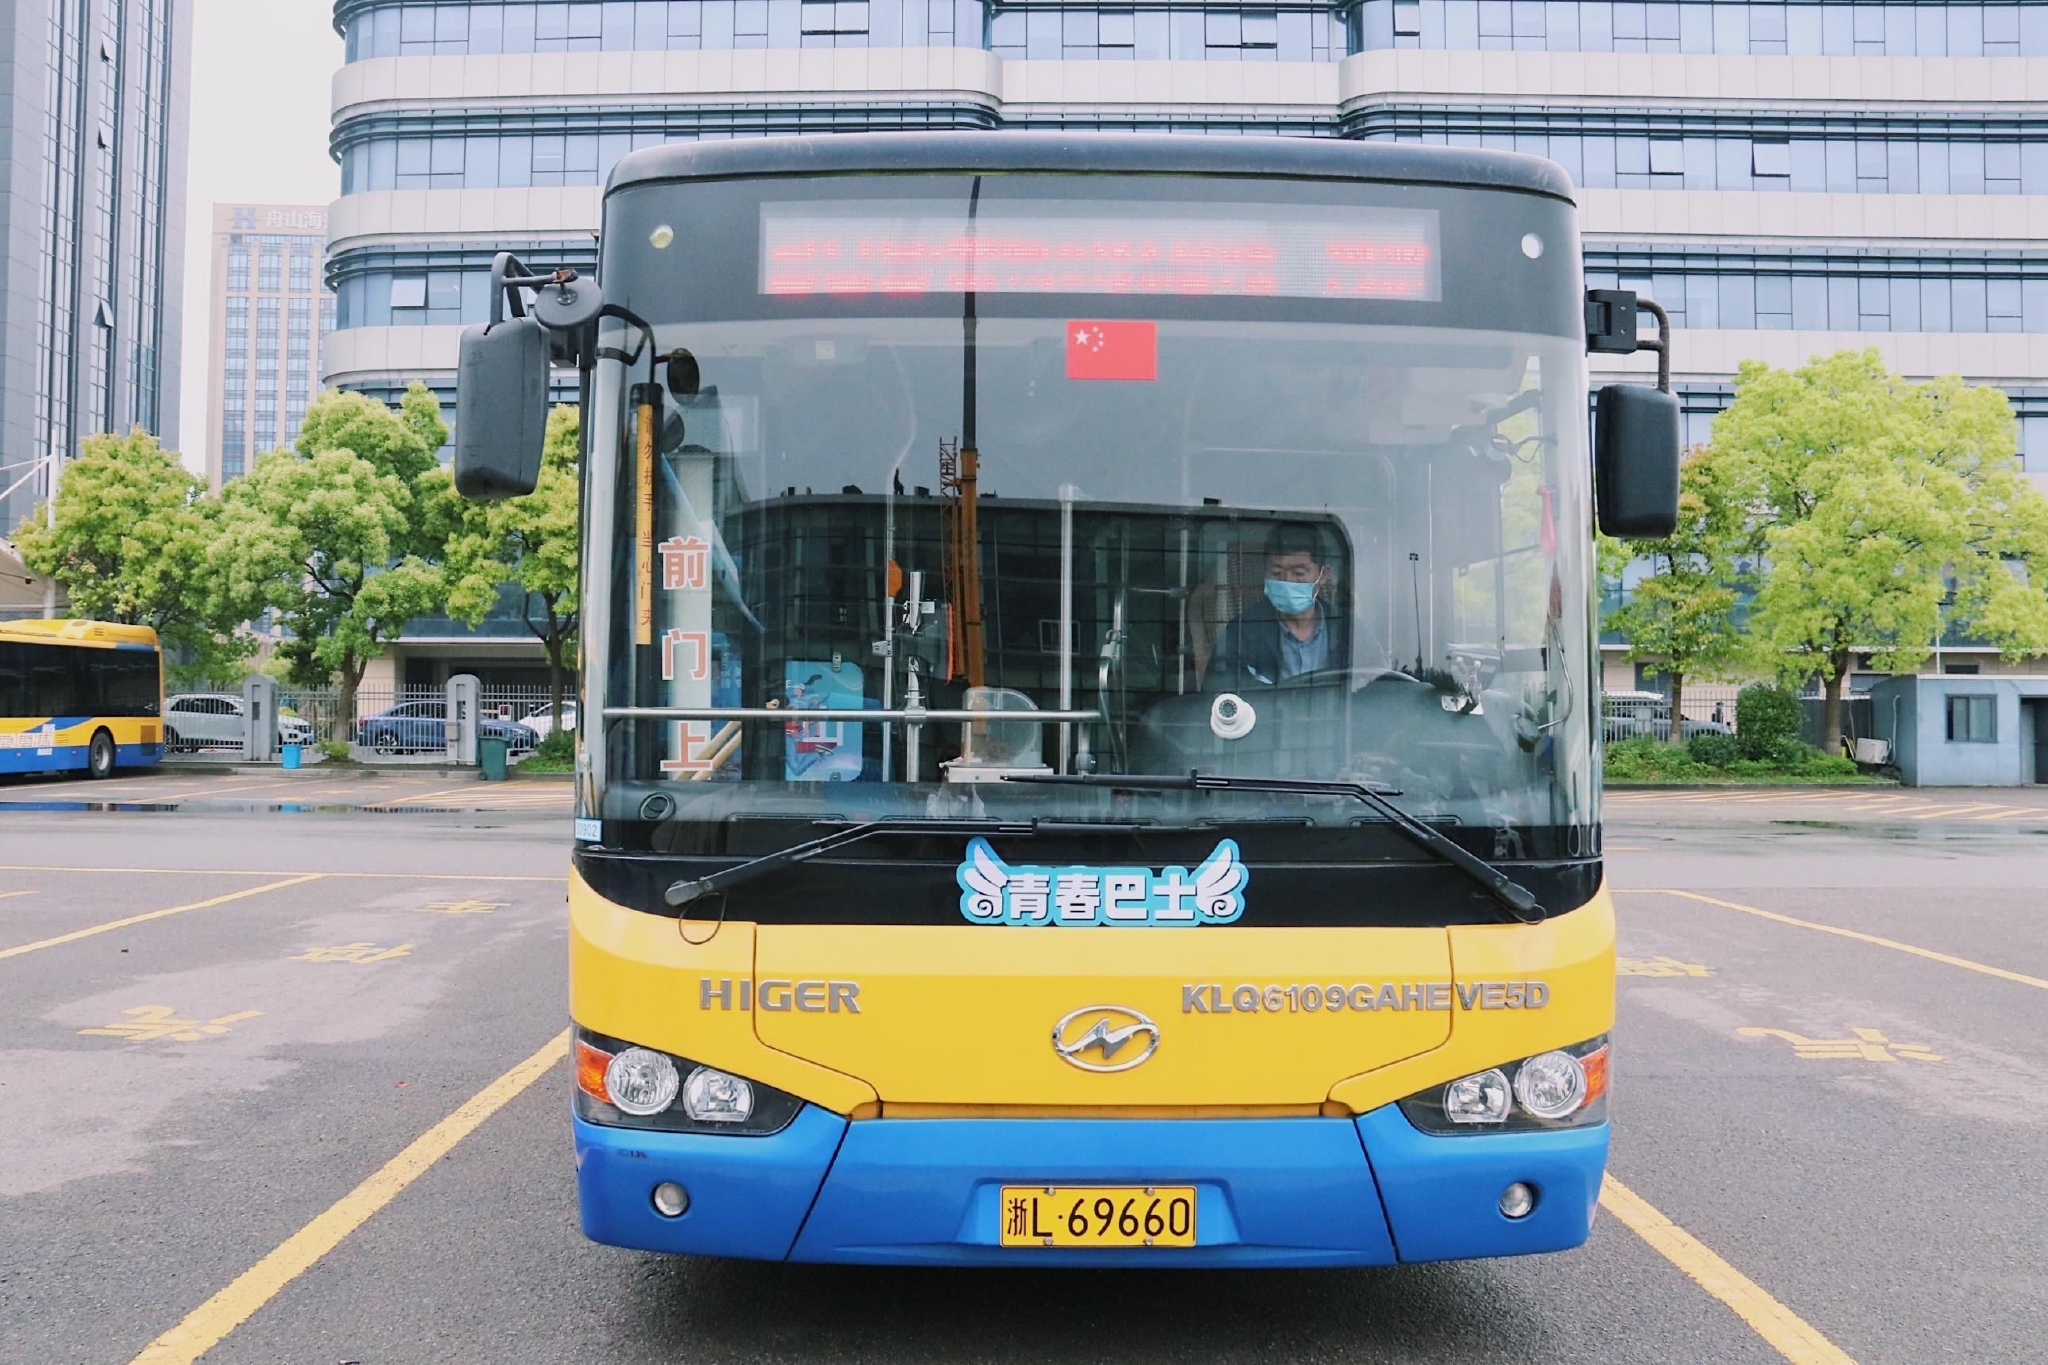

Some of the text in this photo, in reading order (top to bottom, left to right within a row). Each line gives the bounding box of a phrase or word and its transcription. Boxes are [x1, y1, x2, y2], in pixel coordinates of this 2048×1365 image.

[266, 209, 328, 230] 舟山海
[658, 535, 713, 771] 前门上
[1008, 873, 1197, 920] 青春巴士
[700, 978, 861, 1013] HIGER
[1182, 981, 1550, 1013] KLQ6109GAHEVE5D
